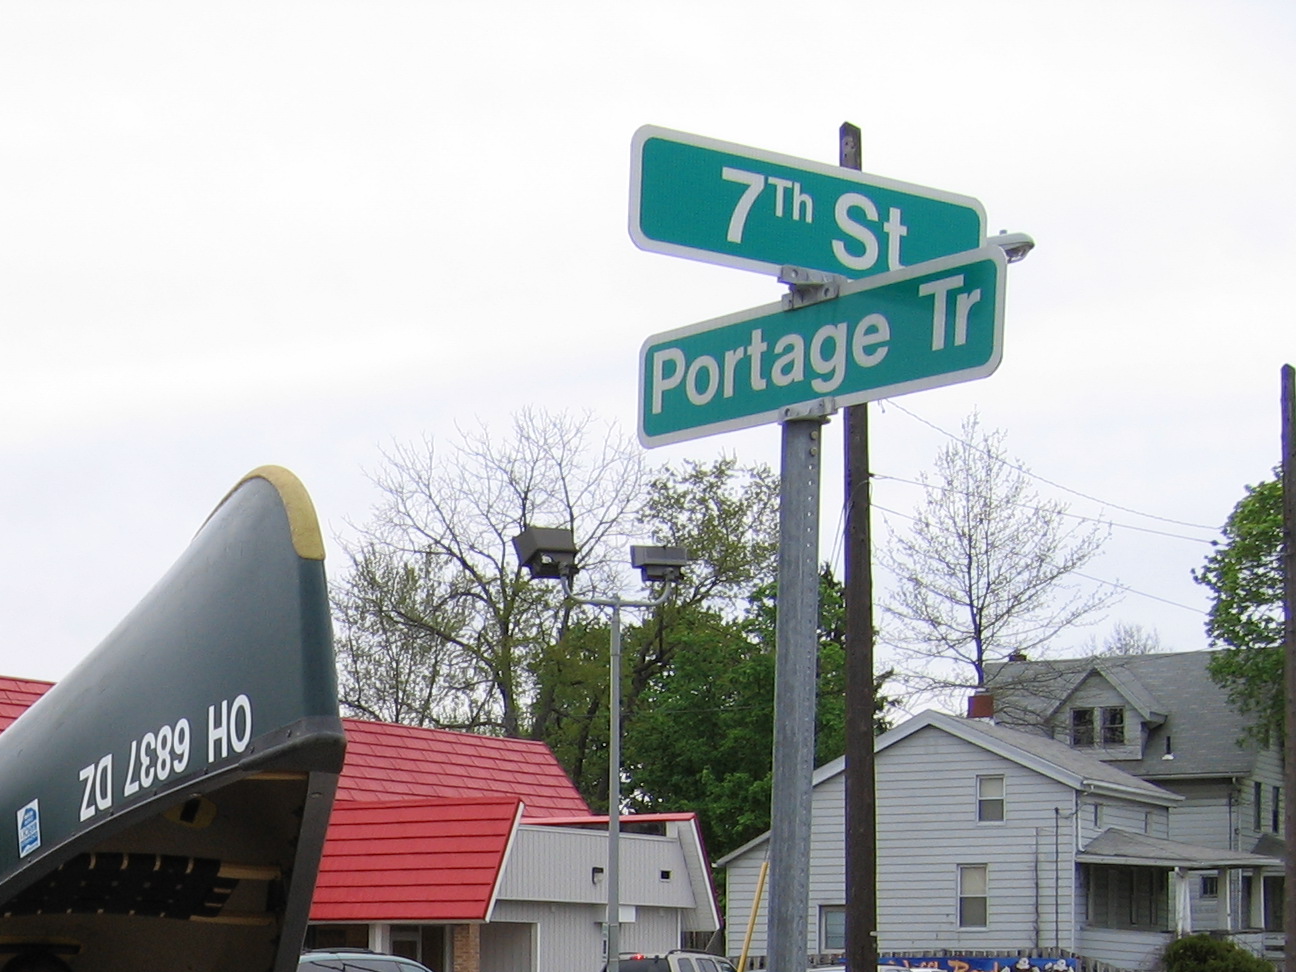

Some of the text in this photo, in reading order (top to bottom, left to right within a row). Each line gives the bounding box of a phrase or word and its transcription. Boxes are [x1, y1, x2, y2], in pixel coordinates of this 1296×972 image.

[831, 192, 908, 271] St
[651, 274, 982, 414] Portage Tr
[78, 693, 253, 822] OH 6837 DZ
